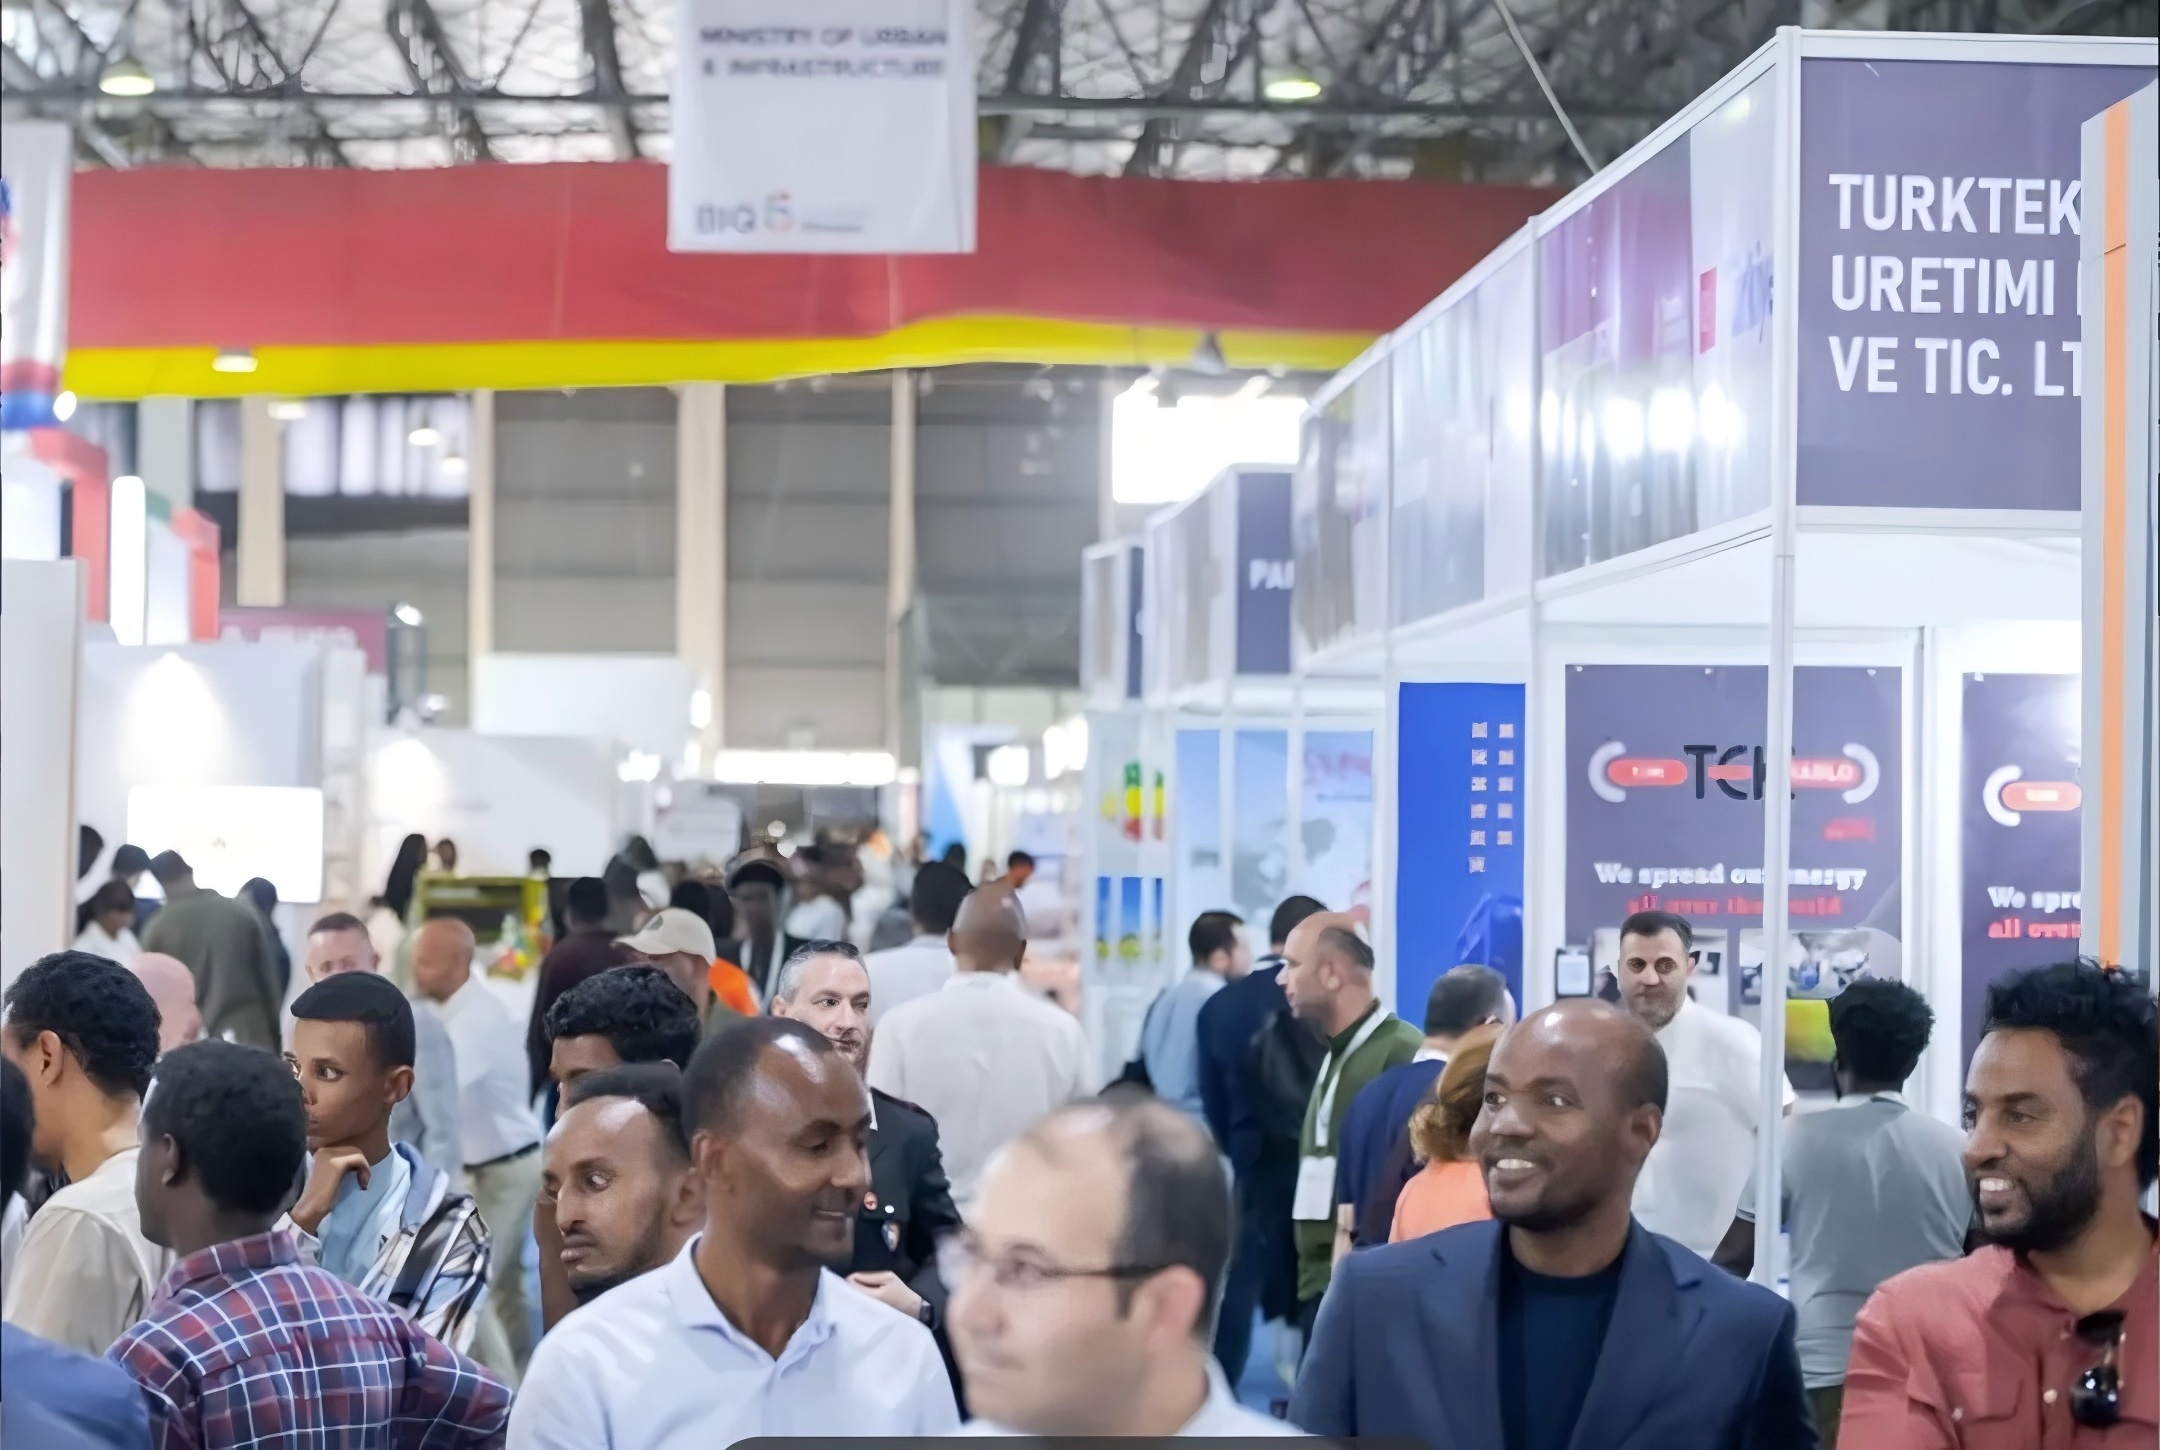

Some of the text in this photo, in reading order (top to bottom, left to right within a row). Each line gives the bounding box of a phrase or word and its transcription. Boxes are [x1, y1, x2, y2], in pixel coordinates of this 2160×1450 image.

[1828, 173, 2081, 235] TURKTEK
[1831, 254, 2054, 315] URETIMI
[1828, 336, 1899, 392] VE
[1915, 337, 2013, 395] TIC.
[1593, 862, 1633, 884] We
[1987, 886, 2027, 908] We
